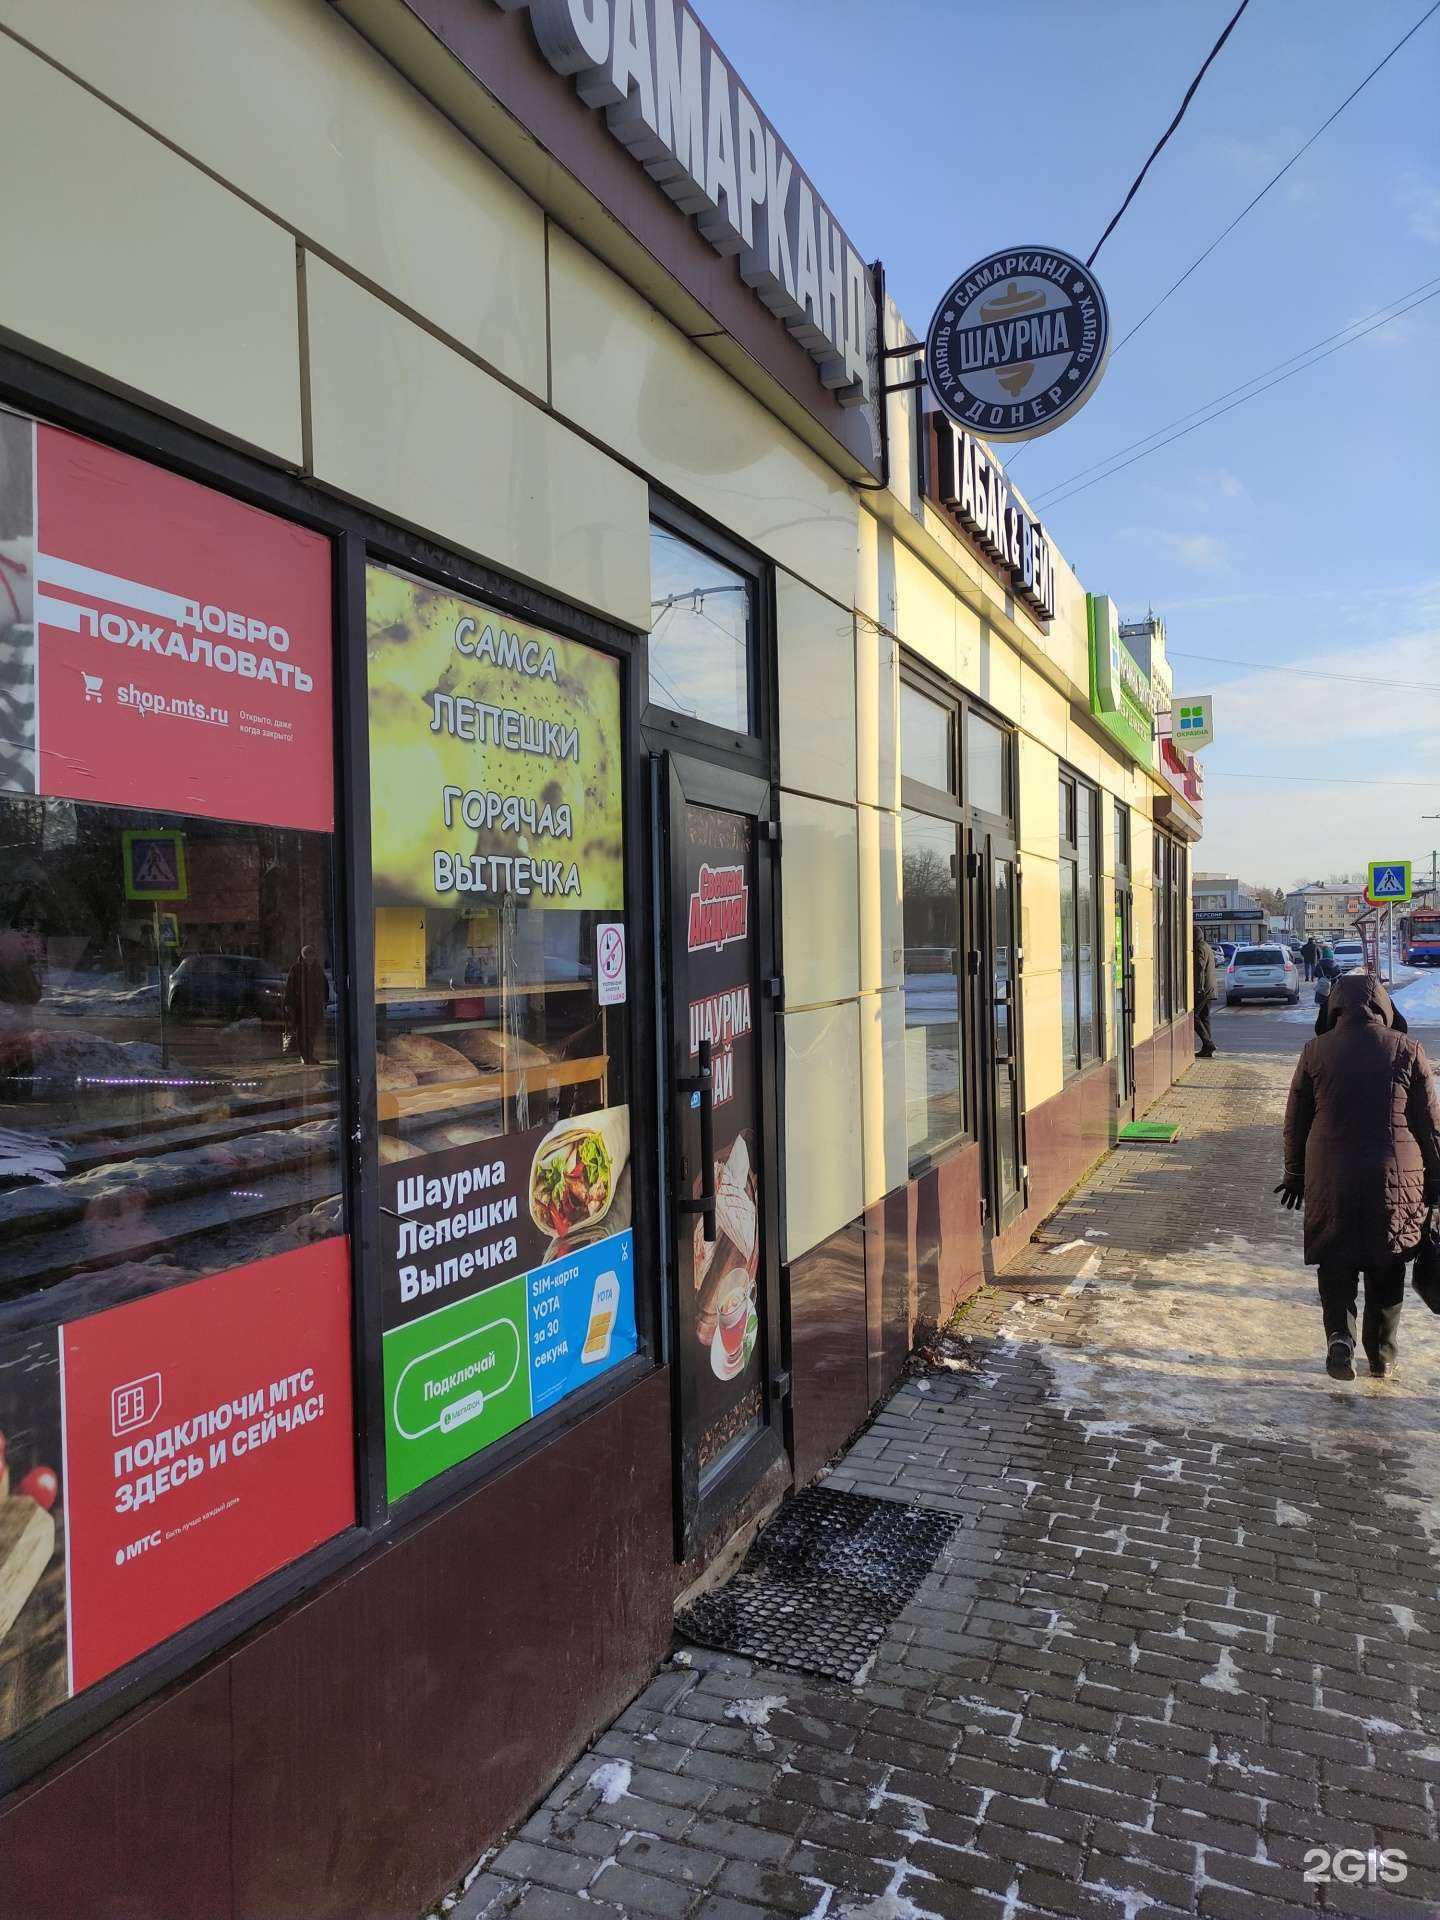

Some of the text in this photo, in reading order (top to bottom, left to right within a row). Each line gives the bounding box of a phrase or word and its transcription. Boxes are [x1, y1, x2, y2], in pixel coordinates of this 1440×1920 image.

[955, 255, 1072, 307] САМАРКАНД
[936, 326, 956, 390] ХАЛЯЛЬ
[960, 311, 1070, 371] ШАУРМА
[1078, 295, 1097, 364] ХАЛЯЛЬ
[965, 386, 1065, 425] ДОНЕР
[949, 420, 1010, 564] ТАБАК
[80, 607, 313, 693] ПОЖАЛОВАТЬ
[177, 600, 290, 653] ДОБРО
[455, 617, 558, 683] САМСА
[117, 682, 229, 725] shop.mts.ru
[430, 693, 579, 762] ЛЕПЕШКИ
[443, 785, 572, 838] ГОРЯЧАЯ
[433, 851, 581, 896] ВЫПЕЧКА
[690, 986, 751, 1054] ШАУРМА
[711, 1044, 733, 1108] АЙ
[396, 1160, 505, 1215] Шаурма
[396, 1195, 518, 1260] Лепешки
[399, 1236, 518, 1304] Выпечка
[532, 1266, 579, 1297] SIM-карта
[533, 1296, 560, 1320] YOTA
[534, 1319, 559, 1344] за 30
[424, 1351, 496, 1402] Подключай
[535, 1341, 569, 1368] секунд
[114, 1368, 314, 1478] ПОДКЛЮЧИ МТС
[115, 1394, 325, 1514] ЗДЕСЬ И СЕЙЧАС!
[127, 1530, 162, 1561] МТС
